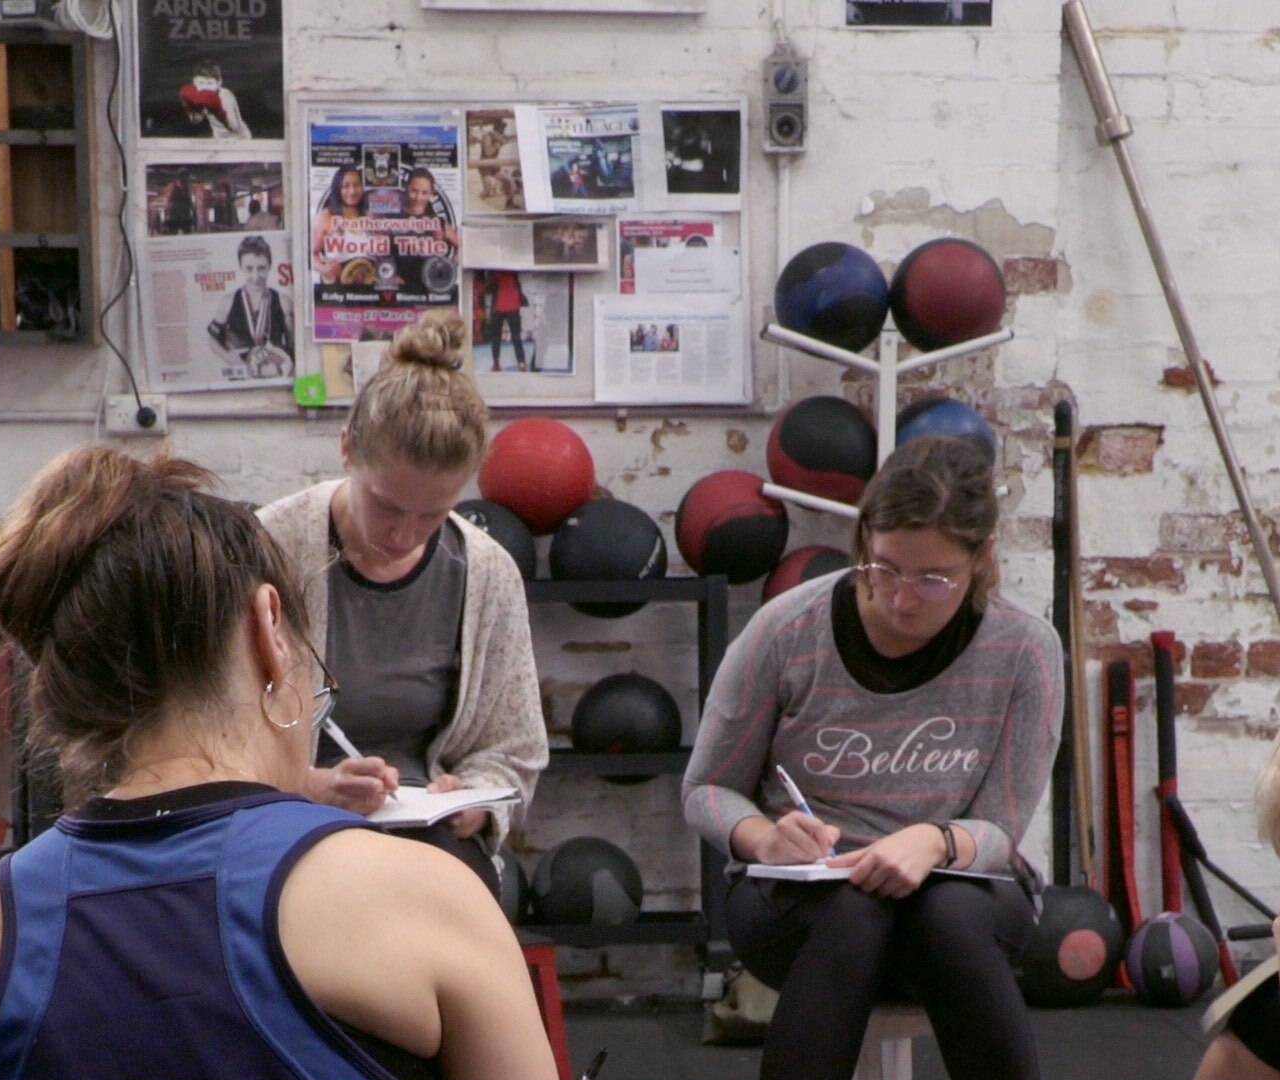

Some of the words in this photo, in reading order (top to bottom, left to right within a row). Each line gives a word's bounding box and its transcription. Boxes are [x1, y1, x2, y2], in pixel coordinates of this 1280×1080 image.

[153, 0, 267, 17] ARNOLD
[168, 19, 253, 40] ZABLE
[331, 216, 439, 232] Featherweight
[324, 236, 390, 255] World
[394, 236, 449, 256] Title
[380, 310, 414, 321] March
[804, 716, 980, 779] Believe
